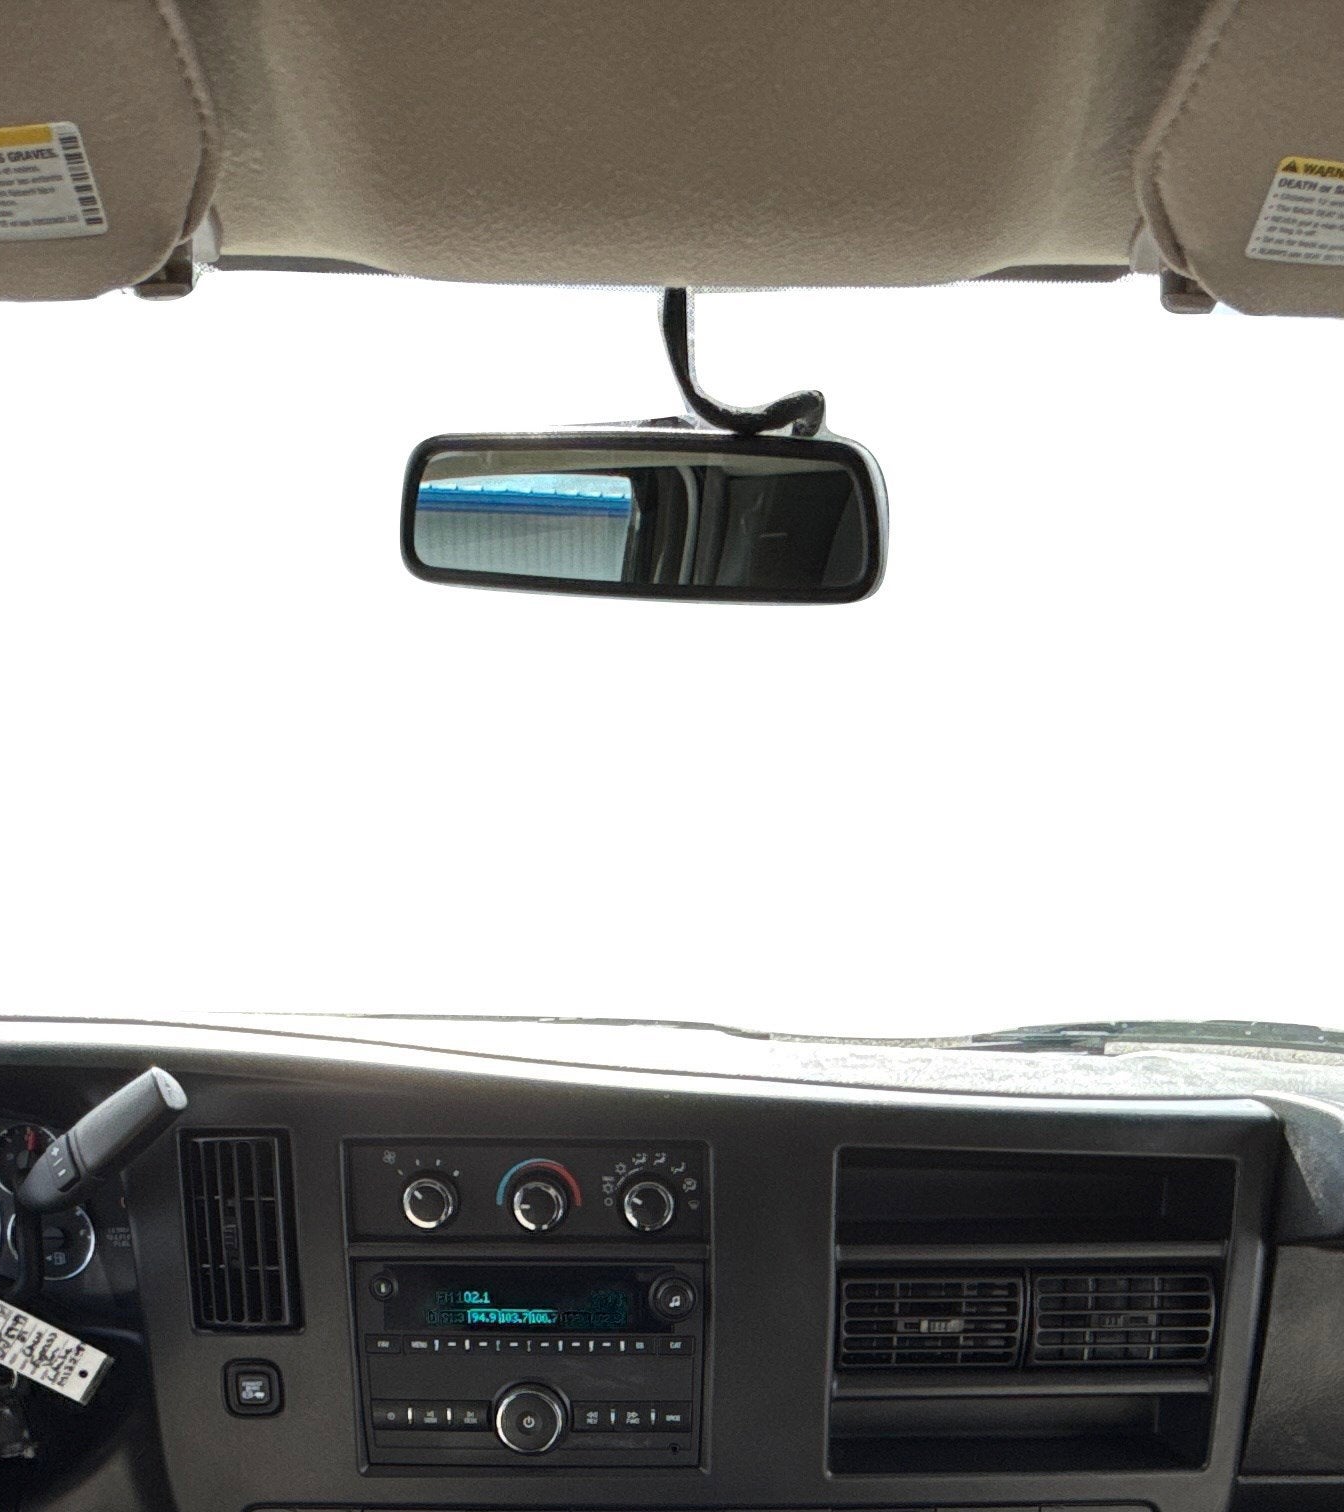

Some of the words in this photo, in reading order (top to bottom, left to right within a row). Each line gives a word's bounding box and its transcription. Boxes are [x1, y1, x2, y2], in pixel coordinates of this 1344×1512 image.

[1278, 177, 1318, 191] DEATH
[1319, 184, 1333, 193] or
[471, 1311, 497, 1324] 94.9
